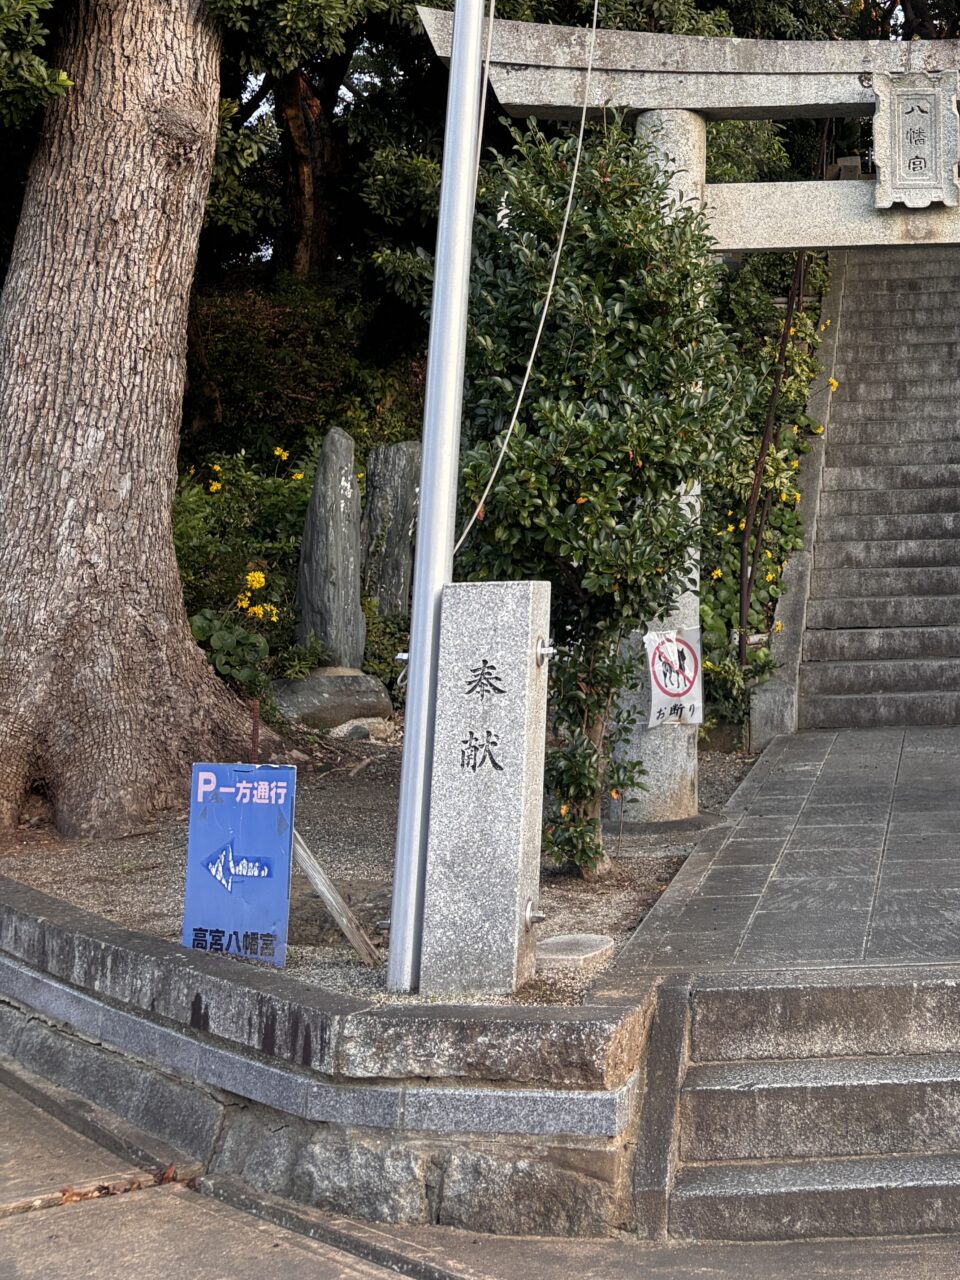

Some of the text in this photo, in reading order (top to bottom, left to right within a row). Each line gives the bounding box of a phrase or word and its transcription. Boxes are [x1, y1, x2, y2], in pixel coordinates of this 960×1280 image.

[905, 105, 928, 171] 八幡宮
[461, 659, 507, 773] 奉献
[656, 702, 696, 720] お断り
[192, 927, 277, 957] 高宮八幡宮
